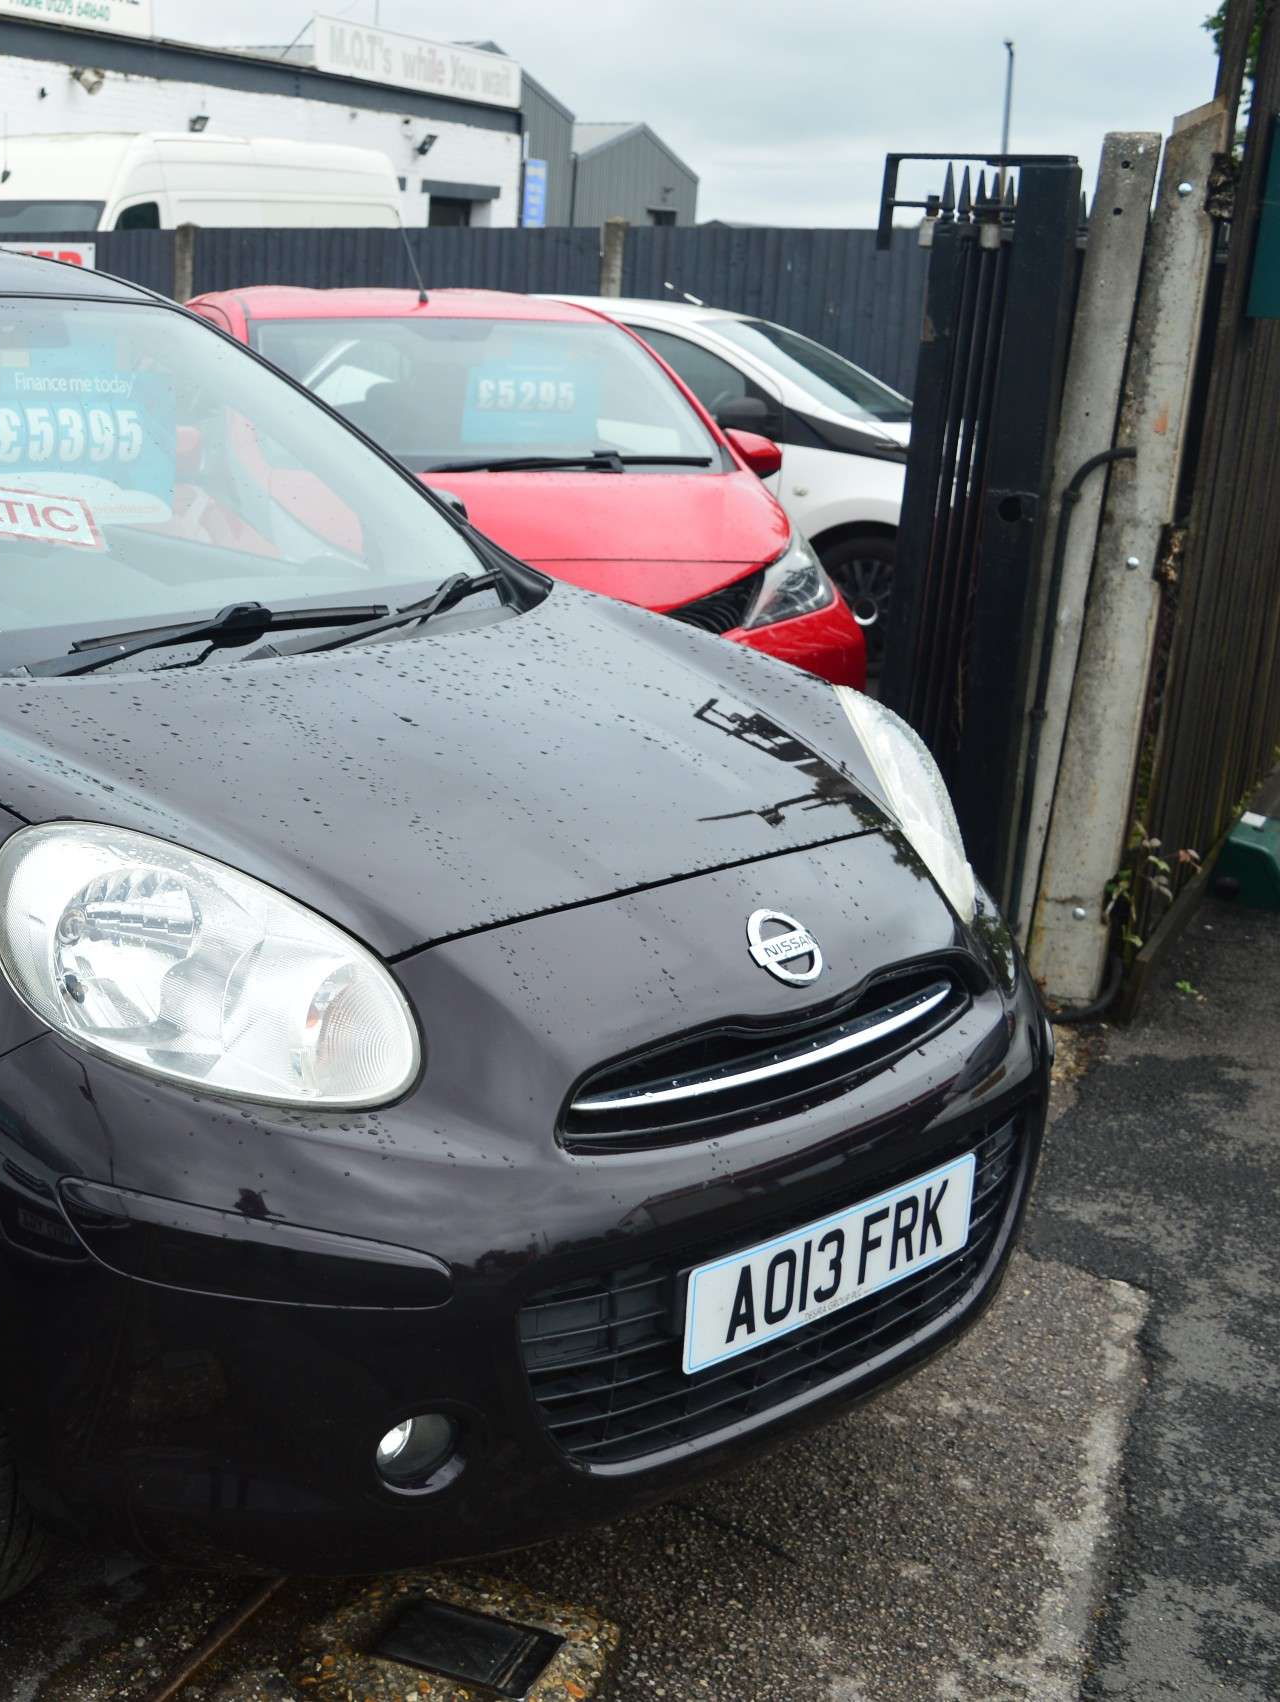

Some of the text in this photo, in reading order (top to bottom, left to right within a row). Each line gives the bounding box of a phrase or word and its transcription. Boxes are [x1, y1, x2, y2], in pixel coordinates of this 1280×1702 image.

[402, 44, 446, 87] while
[14, 372, 133, 398] Finance me today
[763, 934, 816, 958] NISSAN
[725, 1179, 949, 1344] AO13 FRK
